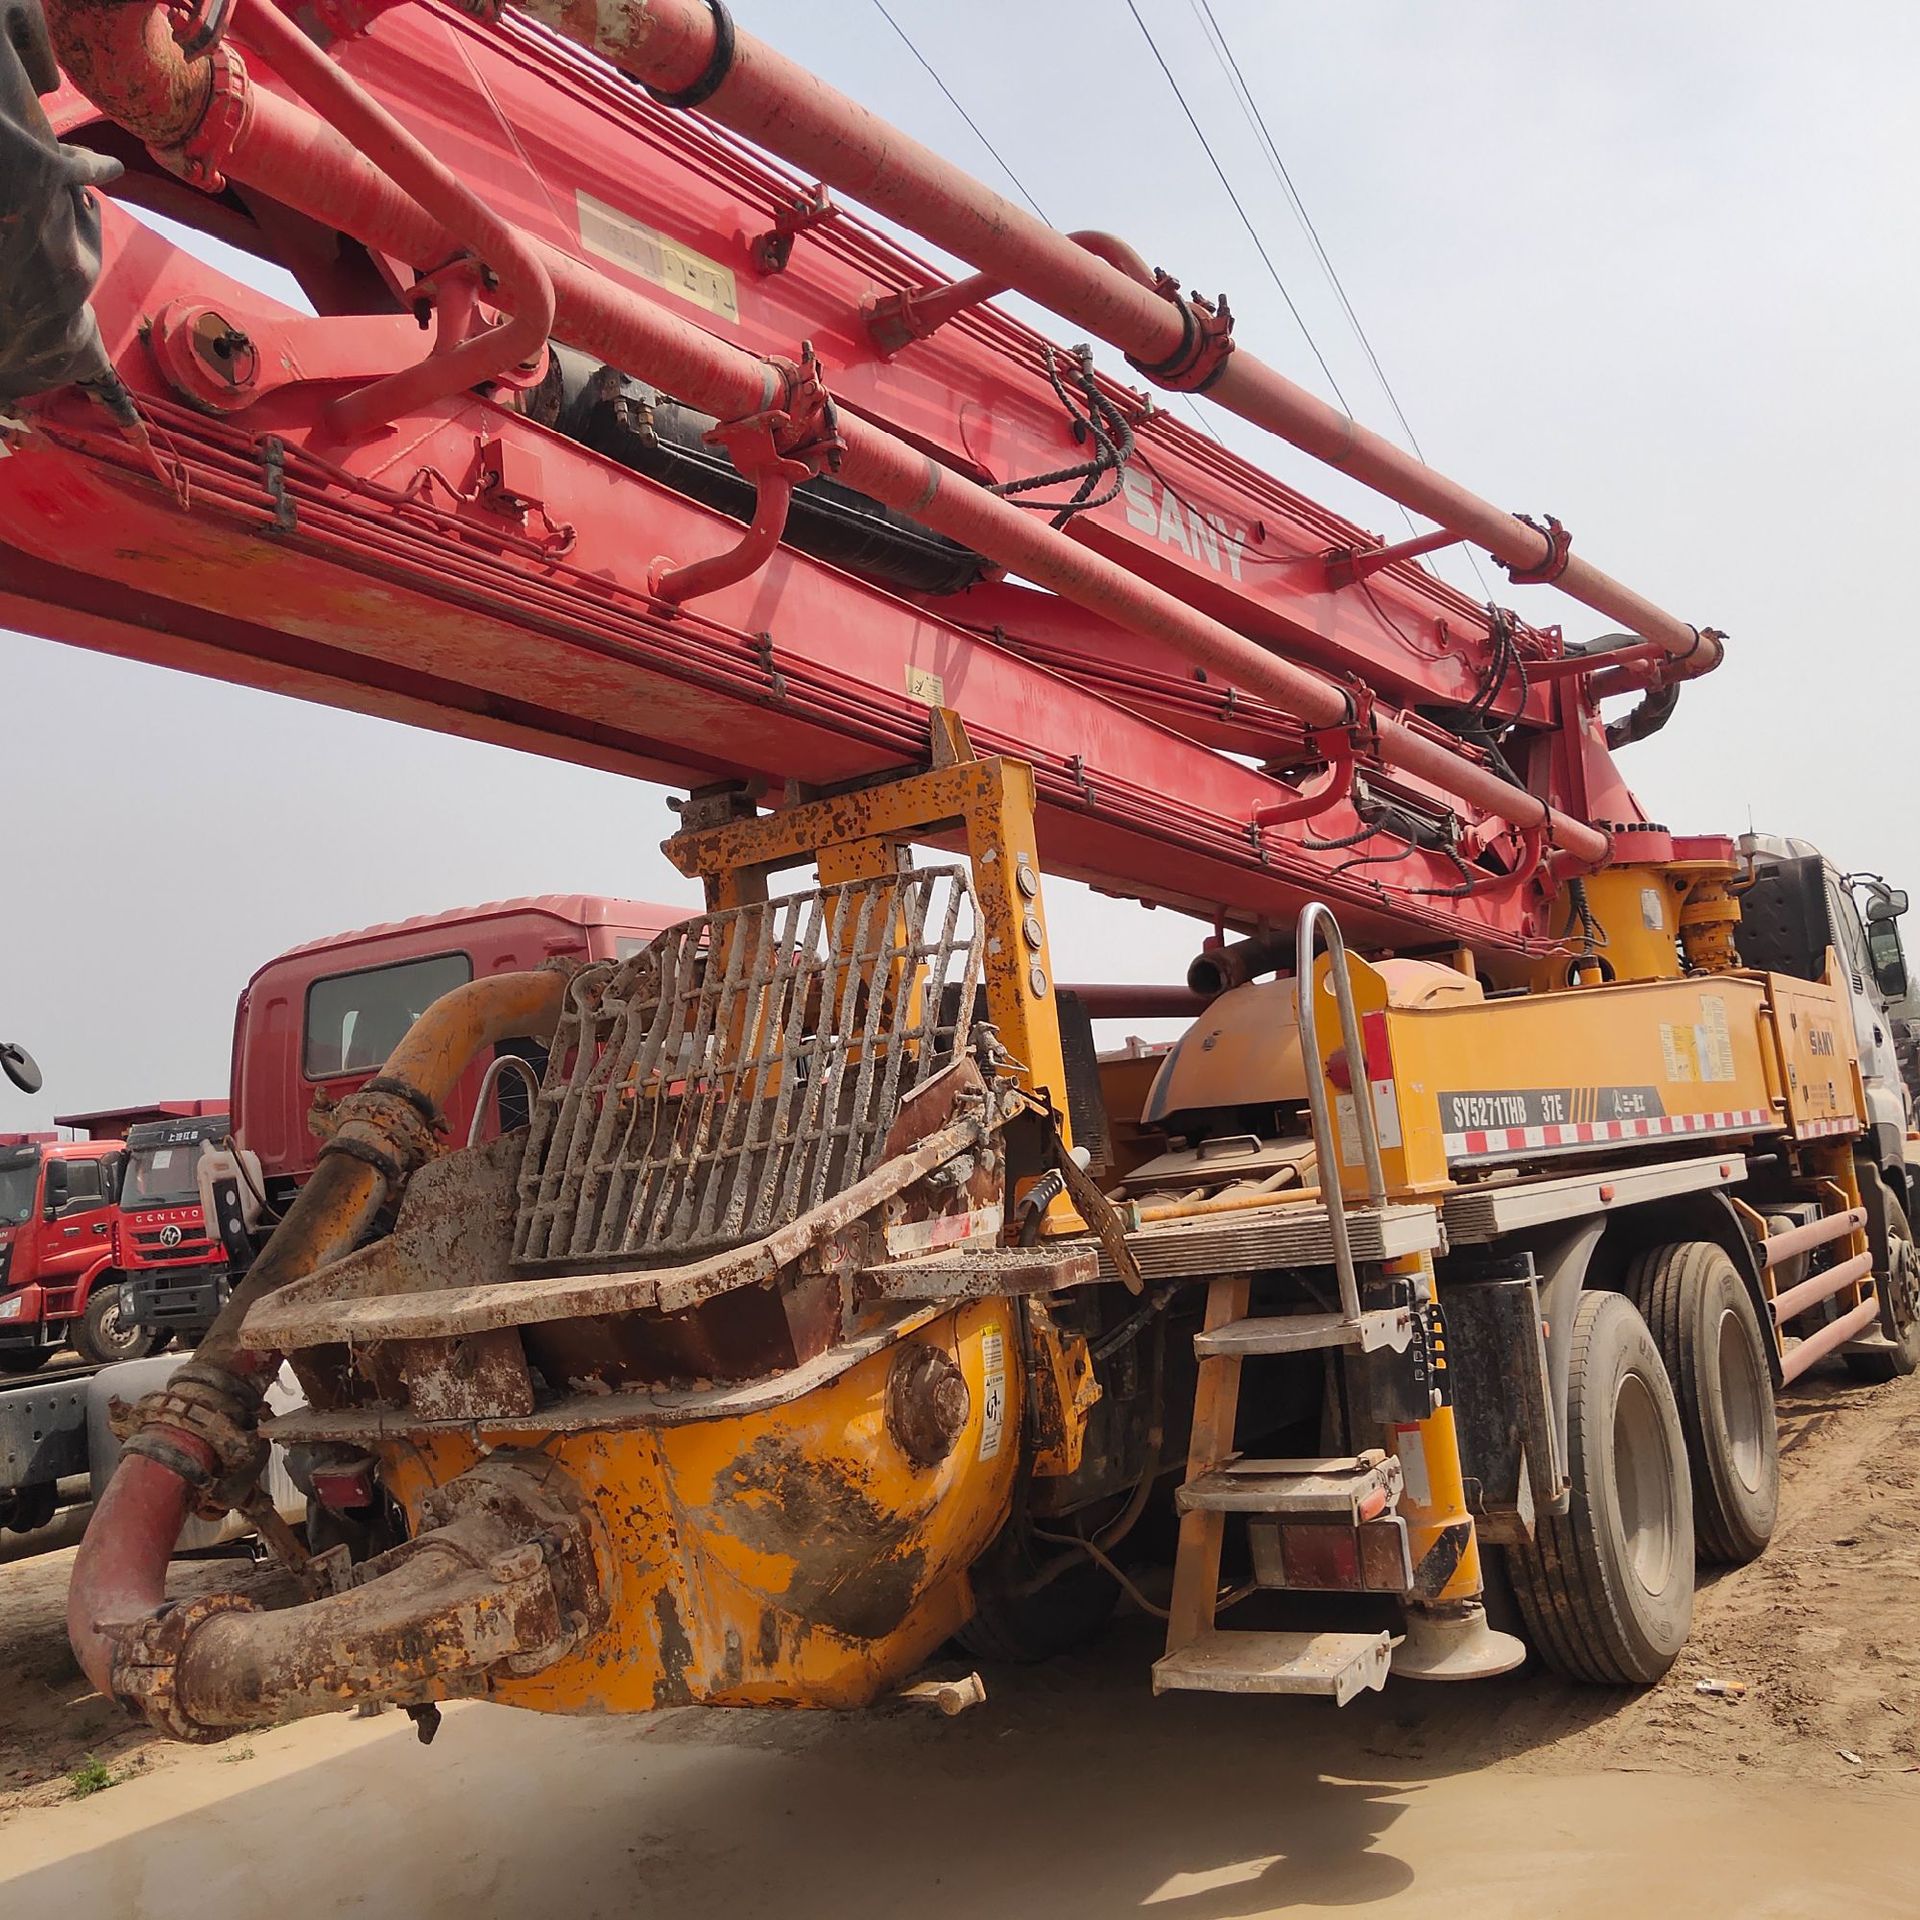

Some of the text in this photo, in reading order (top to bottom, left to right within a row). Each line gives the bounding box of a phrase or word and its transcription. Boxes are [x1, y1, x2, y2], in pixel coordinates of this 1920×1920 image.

[1123, 466, 1246, 582] SANY
[1809, 1030, 1835, 1057] SANY
[1453, 1095, 1564, 1128] SY5271THB 37E
[136, 1210, 199, 1223] GENLYO
